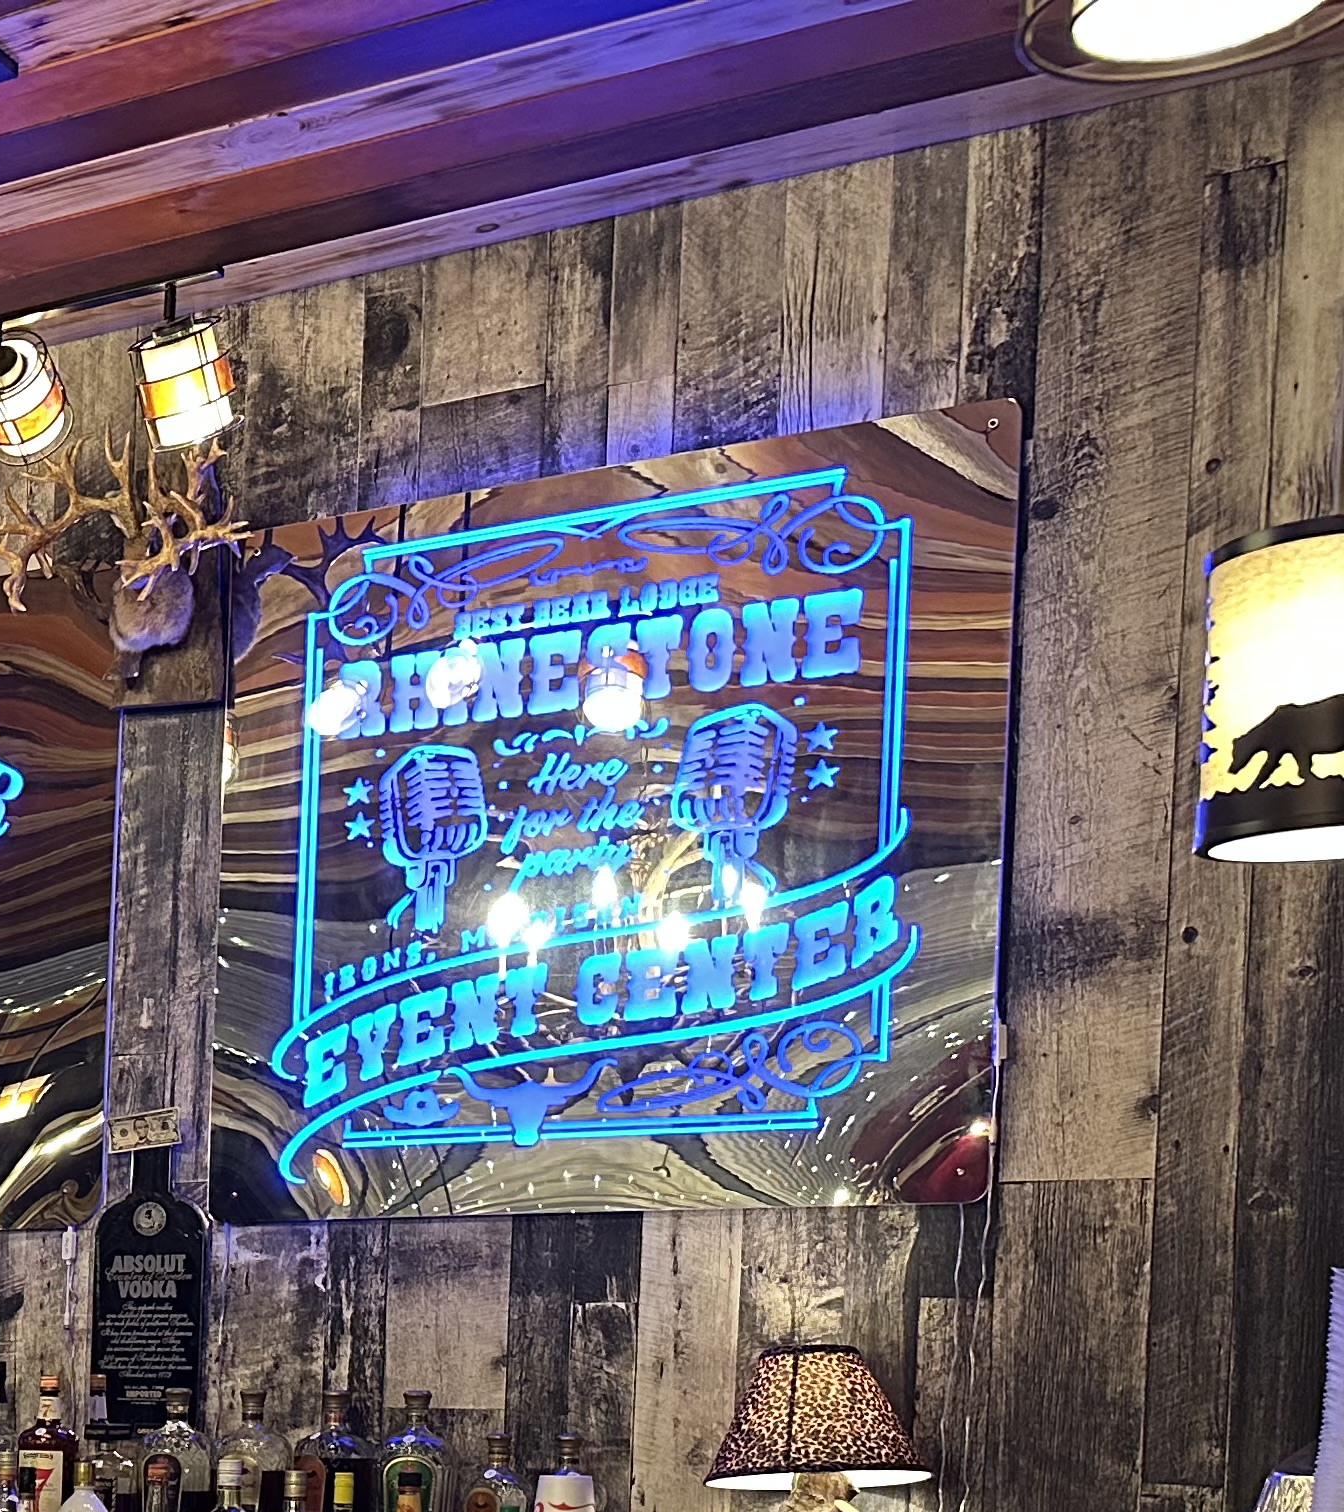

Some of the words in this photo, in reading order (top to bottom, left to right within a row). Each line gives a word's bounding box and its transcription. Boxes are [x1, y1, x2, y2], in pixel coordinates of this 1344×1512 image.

[454, 608, 525, 640] BEST
[533, 587, 611, 625] BEAR
[618, 574, 720, 617] LODGE
[528, 752, 628, 794] Here
[500, 805, 573, 854] for
[577, 786, 646, 834] the
[510, 837, 634, 894] party
[461, 894, 642, 953] MIGAN
[302, 963, 549, 1109] EVENT
[573, 874, 898, 1025] CENTER
[112, 1254, 186, 1273] ABSOLUT
[117, 1280, 177, 1298] VODKA
[41, 1404, 52, 1418] 7
